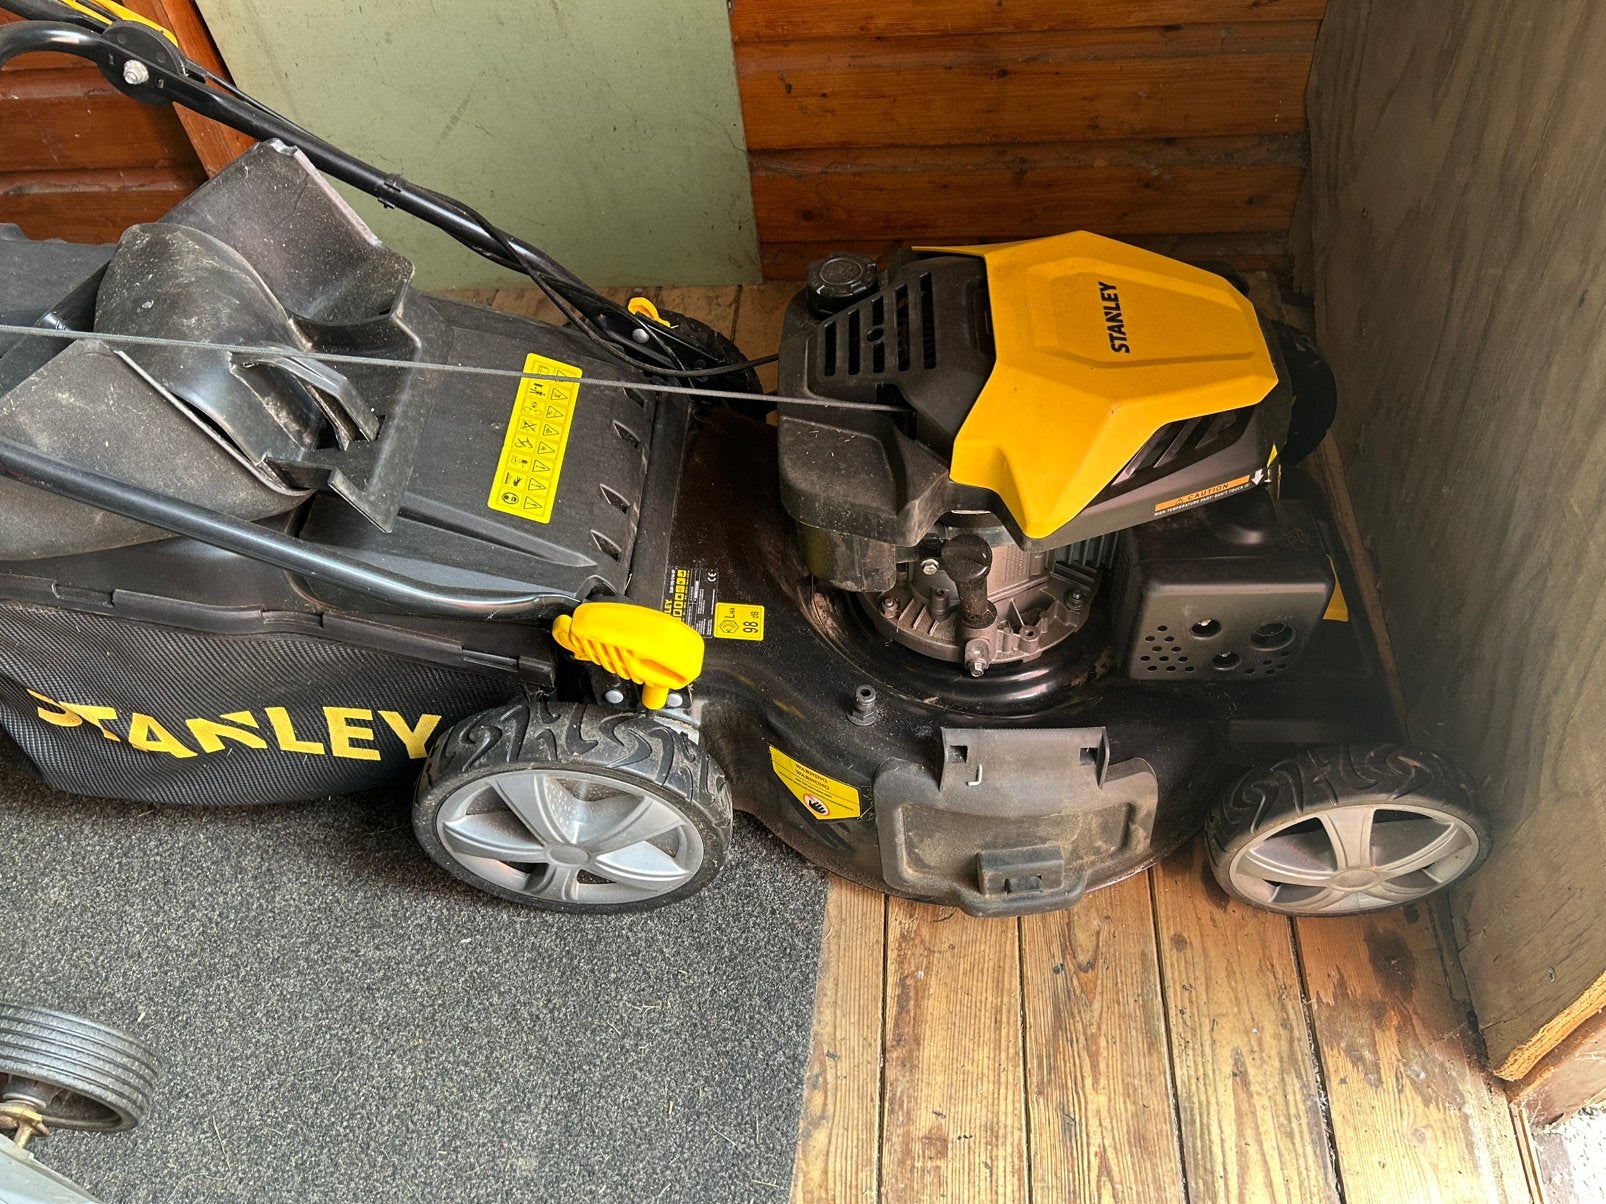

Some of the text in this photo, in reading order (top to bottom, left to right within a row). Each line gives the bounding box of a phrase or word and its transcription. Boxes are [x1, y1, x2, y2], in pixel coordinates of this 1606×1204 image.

[1098, 281, 1130, 354] STANLEY
[1187, 483, 1229, 501] CAUTION
[742, 611, 759, 634] 98 dB
[27, 689, 442, 761] STANLEY
